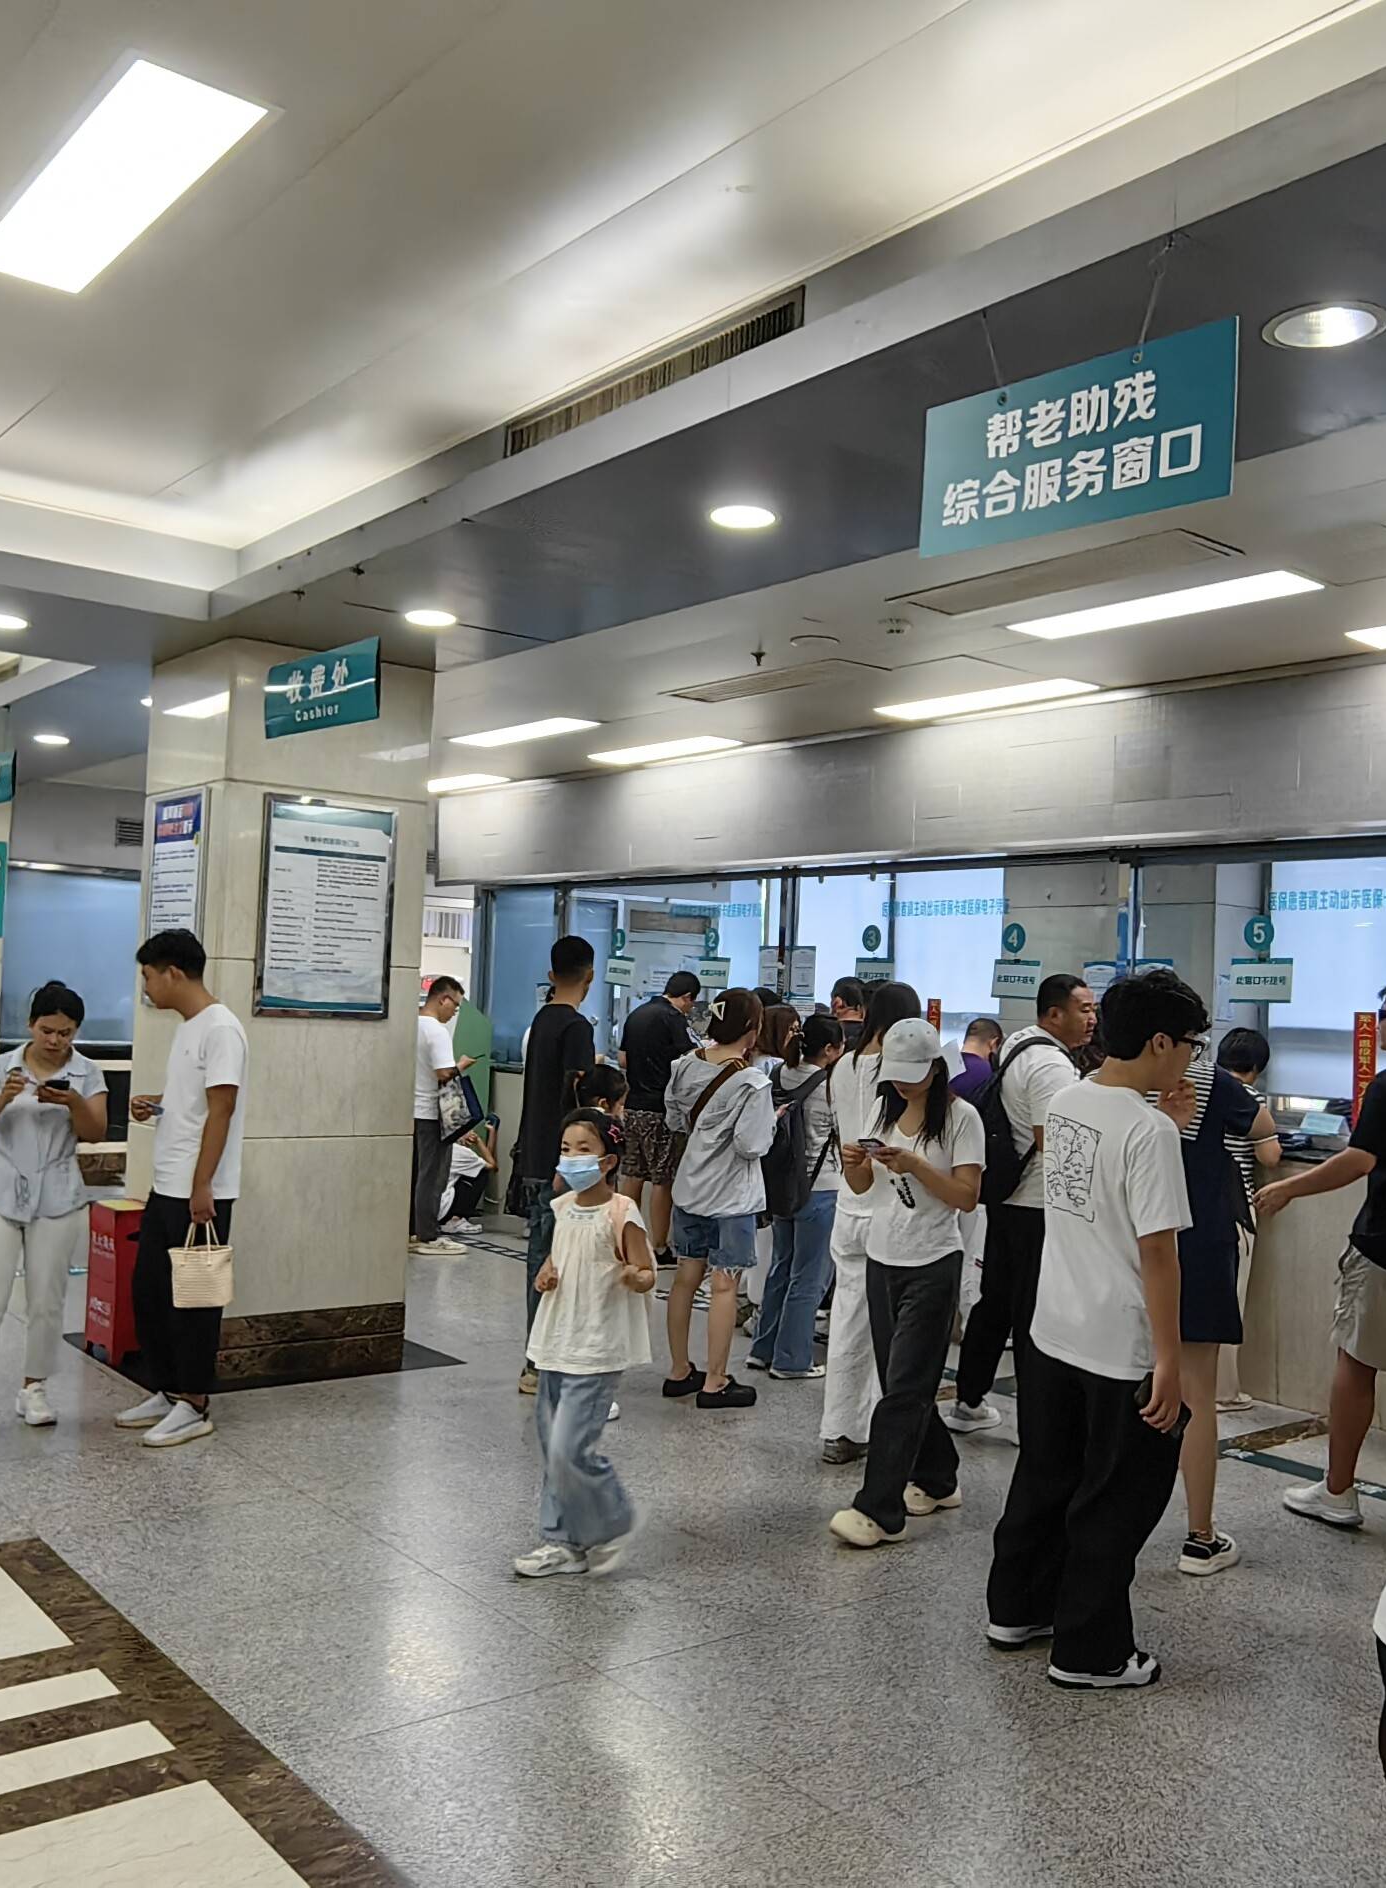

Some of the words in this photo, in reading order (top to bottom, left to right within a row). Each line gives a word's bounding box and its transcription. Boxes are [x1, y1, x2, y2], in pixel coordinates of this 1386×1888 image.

[986, 370, 1156, 458] 帮老助残
[941, 424, 1202, 526] 综合服务窗口
[286, 658, 348, 704] 收费处
[295, 704, 339, 722] Cashier
[708, 931, 717, 947] 2
[865, 929, 877, 948] 3
[1007, 929, 1019, 947] 4
[1253, 922, 1266, 944] 5
